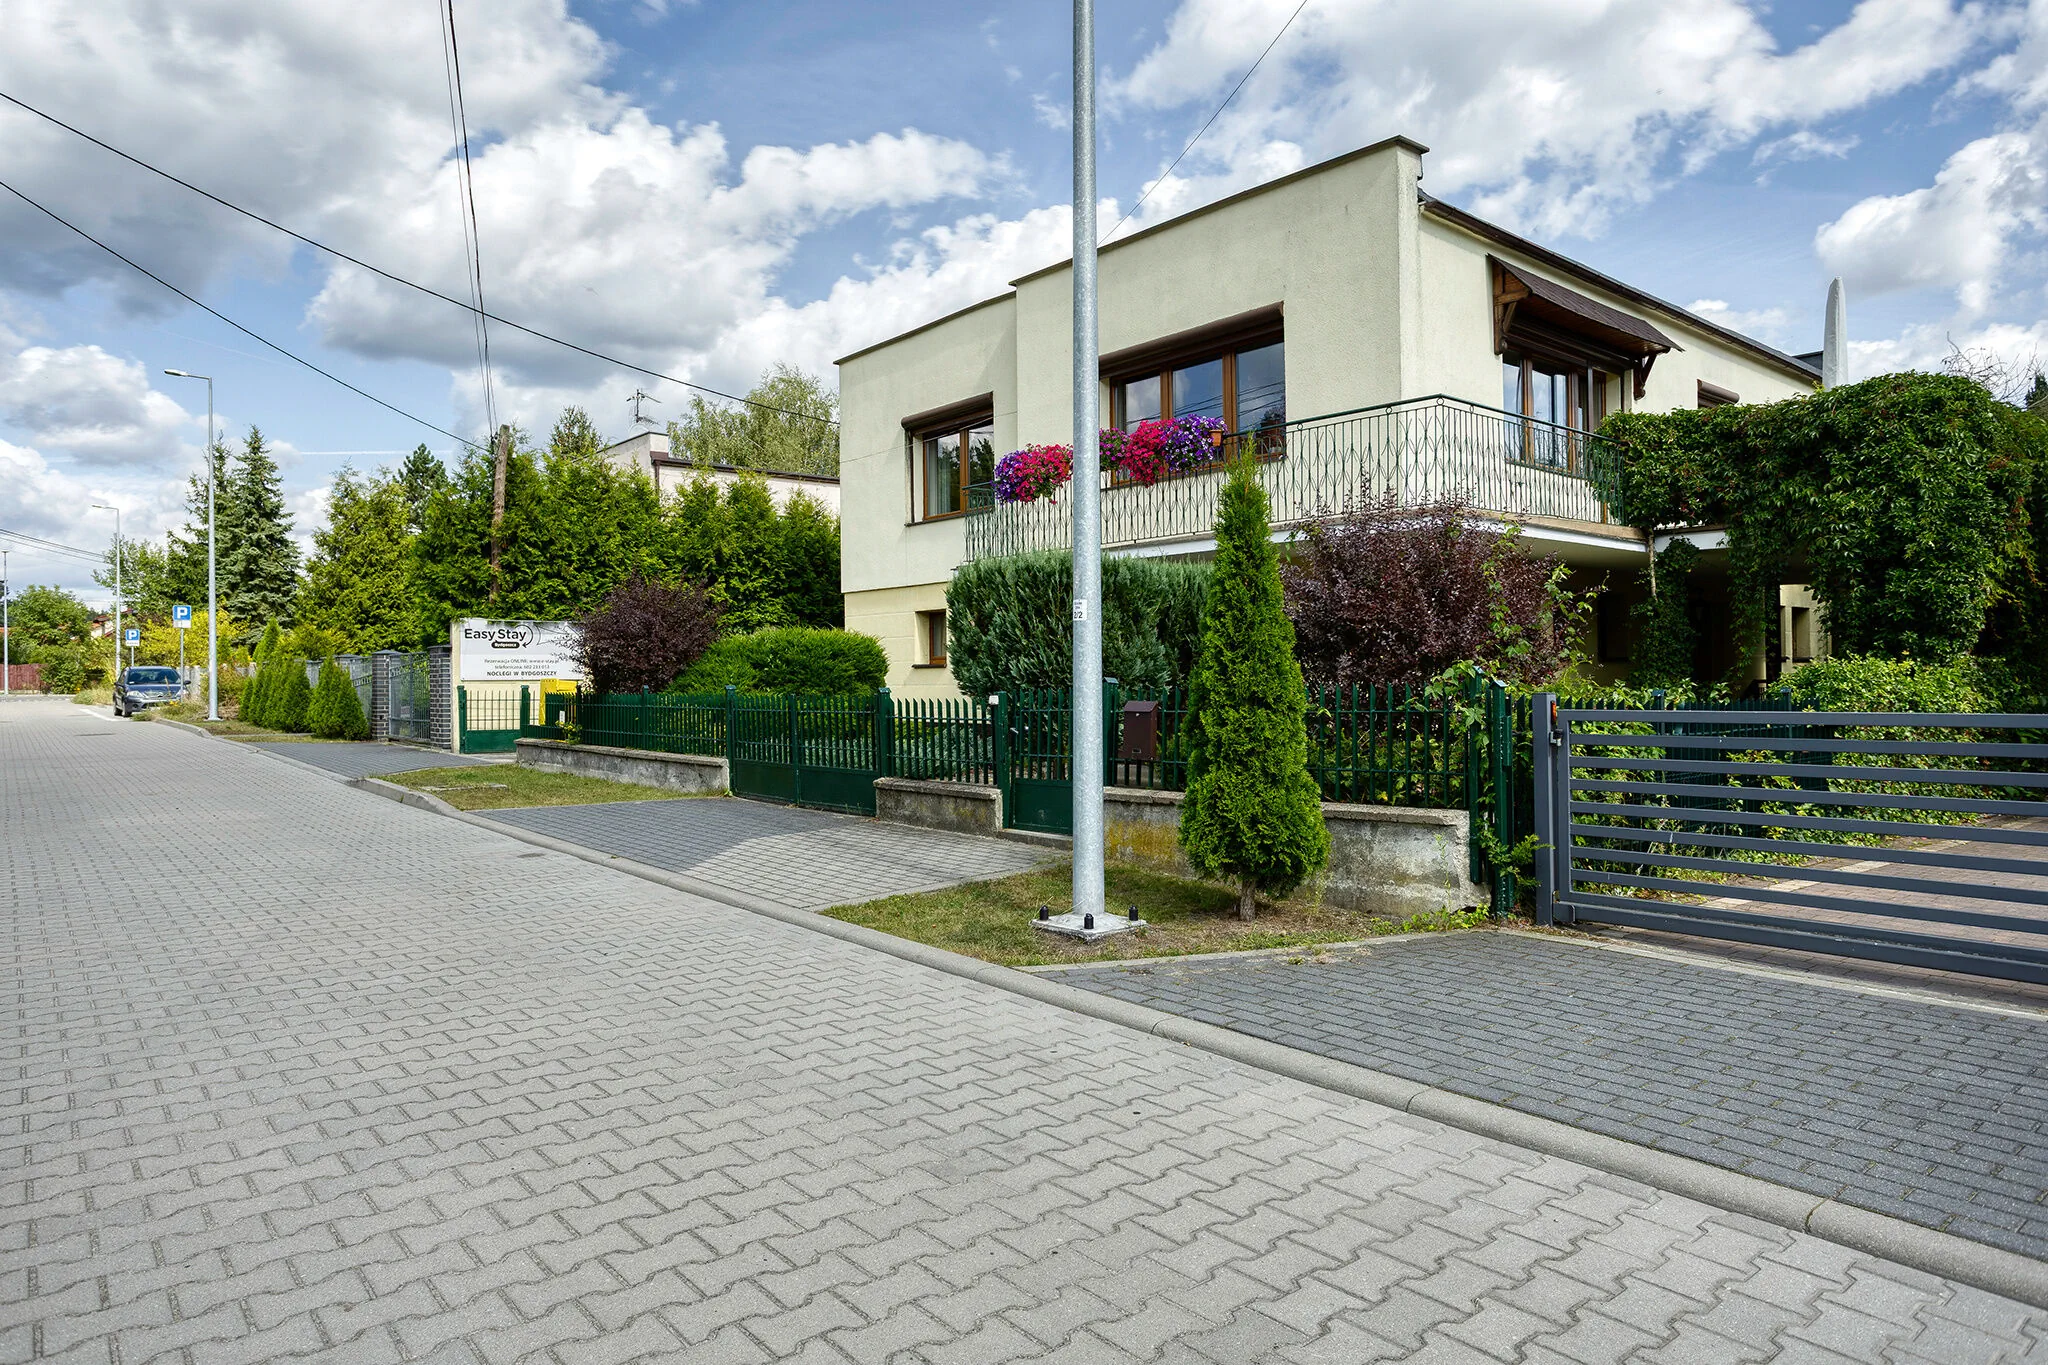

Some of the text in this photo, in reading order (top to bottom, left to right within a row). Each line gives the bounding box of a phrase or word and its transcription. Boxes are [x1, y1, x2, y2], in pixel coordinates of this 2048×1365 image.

[177, 607, 188, 619] P
[464, 628, 527, 641] Easy Stay
